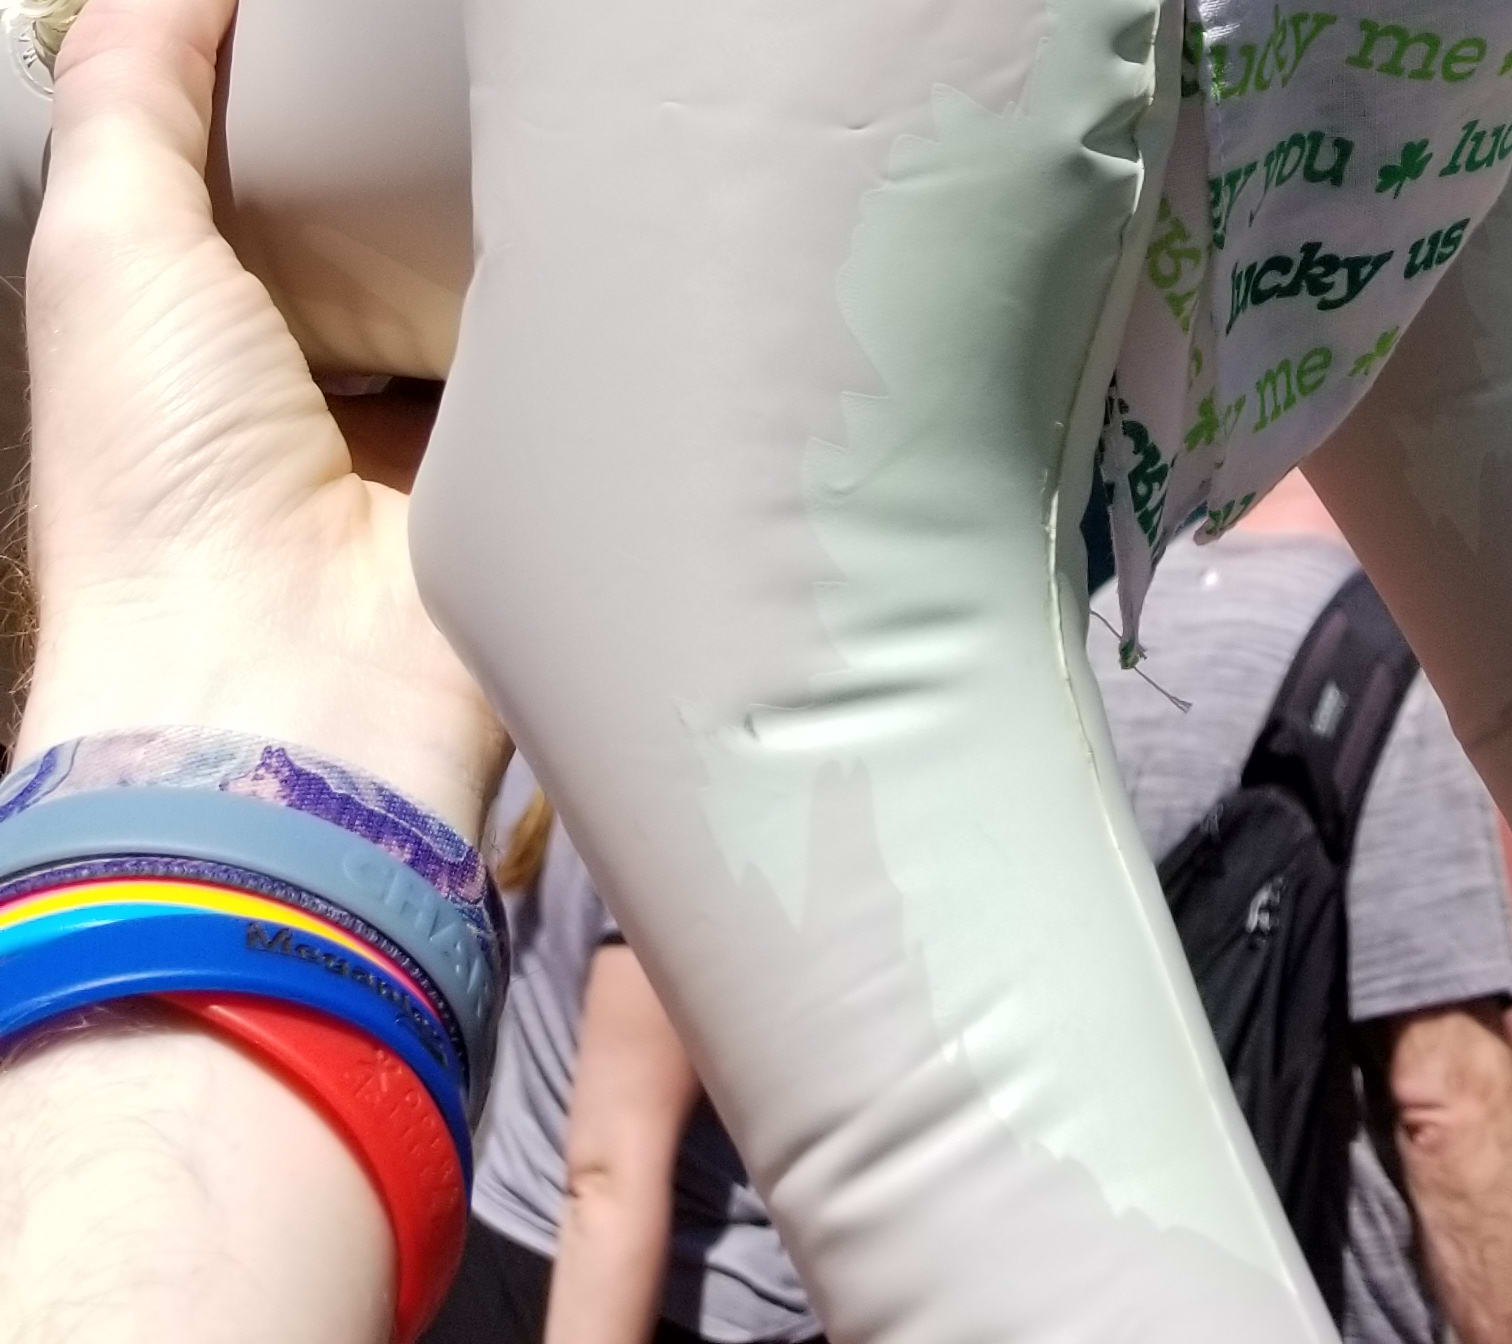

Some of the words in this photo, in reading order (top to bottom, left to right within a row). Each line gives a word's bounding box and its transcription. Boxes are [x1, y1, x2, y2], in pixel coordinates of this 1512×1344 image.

[1346, 17, 1488, 84] me
[1403, 216, 1471, 282] us
[1253, 345, 1334, 433] me
